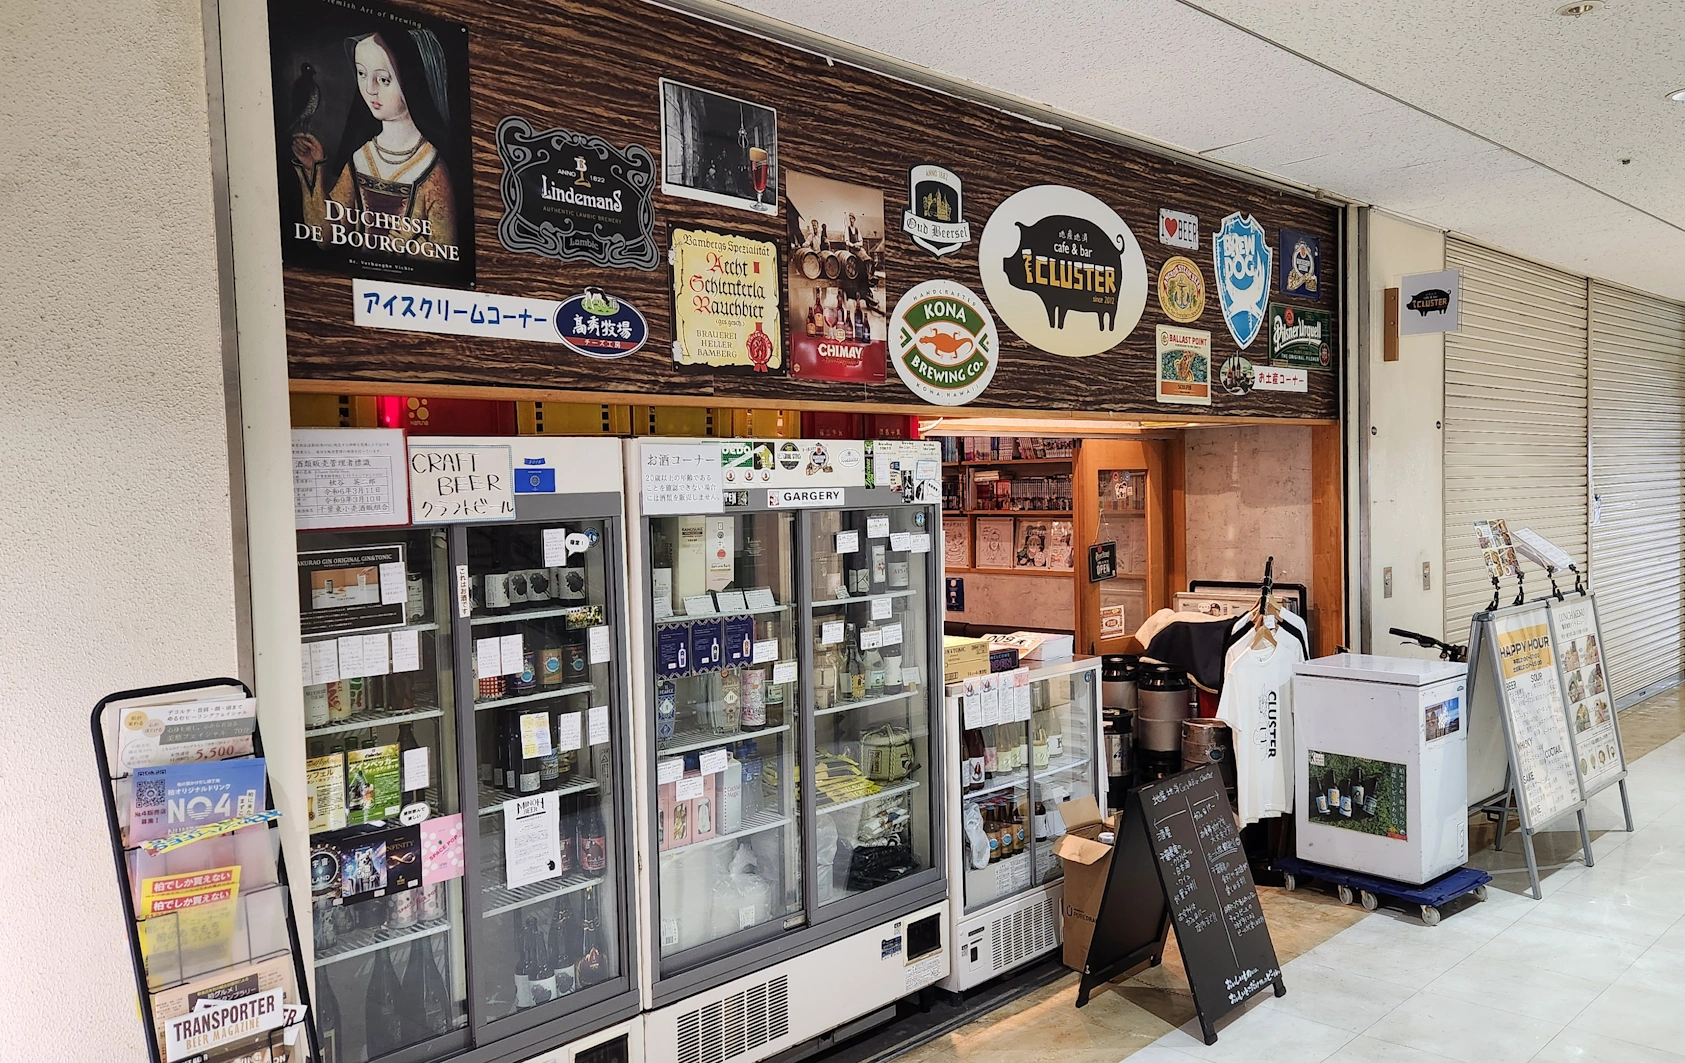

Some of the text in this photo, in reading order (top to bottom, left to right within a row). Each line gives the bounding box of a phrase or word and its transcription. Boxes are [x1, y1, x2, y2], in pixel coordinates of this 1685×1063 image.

[322, 0, 422, 29] lemish Art of Brewing
[557, 168, 606, 184] ANNO 1822
[925, 169, 938, 178] ANNO
[324, 199, 433, 236] DUCHESSE
[542, 206, 622, 225] AUTHENTIC LAMBIC BREWERY
[906, 217, 969, 239] Oud Beersel
[1160, 214, 1198, 243] I BEER
[294, 222, 460, 261] DE BOURGOGNE
[569, 237, 600, 250] Lambic
[682, 234, 727, 253] Bambergs
[1054, 242, 1093, 258] cafe & bar
[1223, 232, 1255, 258] BREW
[706, 252, 748, 278] Aecht
[1035, 255, 1117, 294] CLUSTER
[1224, 254, 1255, 280] DOG
[689, 274, 766, 299] Schlenkerla
[692, 295, 764, 319] Rauchbier
[913, 289, 977, 307] HANDCRAFTED
[1092, 296, 1115, 305] since 2012
[1416, 298, 1447, 308] CLUSTER
[363, 292, 548, 329] アイスクリームコーナー
[924, 301, 967, 323] KONA
[696, 330, 737, 340] BRAUEREI
[1169, 334, 1191, 344] BALLAST
[1192, 337, 1207, 346] POINT
[1273, 314, 1322, 352] Pilsner Urquell
[584, 338, 621, 349] チーズ工房
[701, 339, 732, 348] HELLER
[818, 343, 863, 359] CHIMAY
[697, 349, 737, 358] BAMBERG
[911, 355, 984, 384] BREWING CO.
[1258, 371, 1304, 386] お土産コーナー
[916, 382, 979, 398] KONA, HAWAII
[411, 452, 480, 474] CRAFT
[647, 453, 715, 467] お酒コーナー
[437, 474, 502, 496] BEER
[645, 474, 712, 482] 20歳以上の年齢である
[647, 484, 717, 492] ことを確認できない場合
[783, 491, 840, 501] GARGERY
[421, 498, 514, 518] クラフトビール
[333, 556, 361, 564] ORIGINAL
[1096, 563, 1110, 576] OPEN
[1500, 636, 1550, 659] HAPPY HOUR
[1506, 680, 1517, 692] BEER
[1267, 691, 1277, 758] CLUSTER
[195, 745, 235, 761] 5,500
[1523, 771, 1534, 785] SAKE
[168, 783, 231, 796] 柏オリジナルドリンク
[516, 797, 545, 816] MINOH
[1530, 804, 1542, 818] WINE
[429, 834, 459, 861] SPACE POP
[154, 872, 231, 892] 柏でしか買えない
[153, 891, 230, 912] 柏でしか買えない
[173, 995, 275, 1042] TRANSPORTER
[186, 1017, 261, 1050] BEER MAGAZINE
